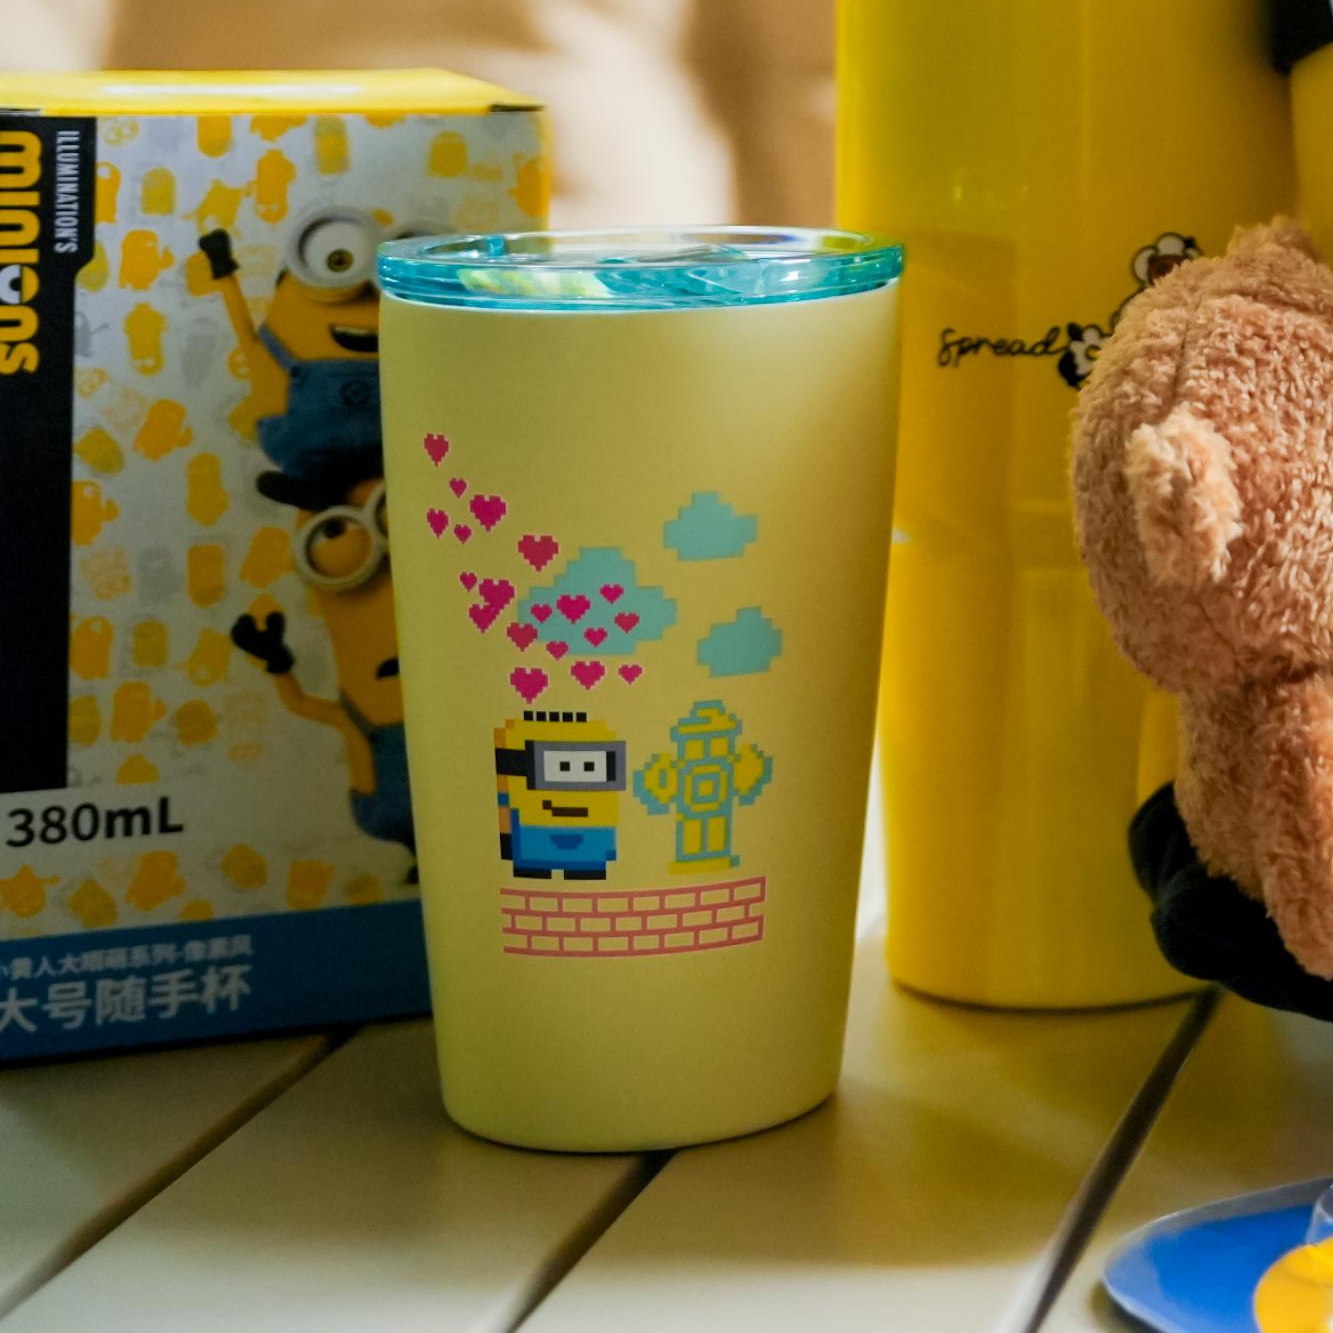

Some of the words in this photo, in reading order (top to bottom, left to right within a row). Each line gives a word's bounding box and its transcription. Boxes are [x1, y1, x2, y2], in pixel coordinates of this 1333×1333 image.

[54, 130, 80, 253] ILLUMINATION'S
[937, 327, 1066, 368] Spread
[6, 796, 184, 847] 380mL
[0, 964, 252, 1032] 大号随手杯
